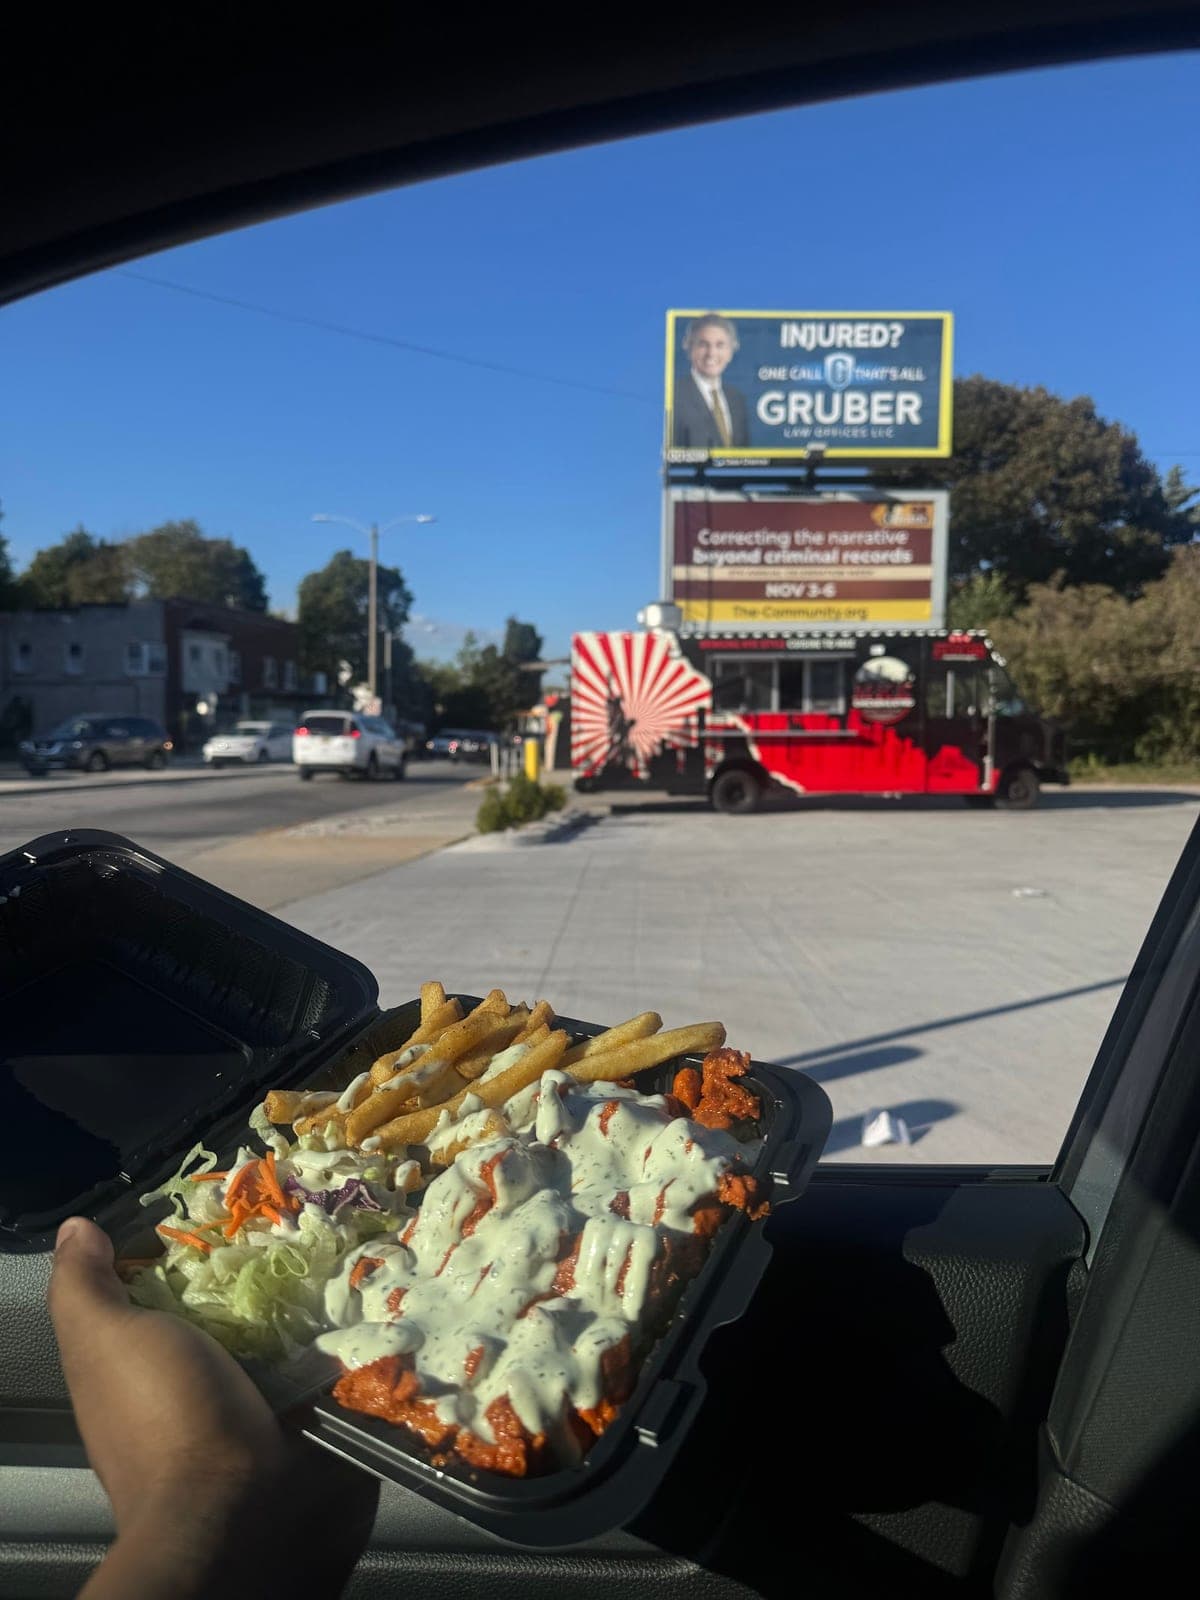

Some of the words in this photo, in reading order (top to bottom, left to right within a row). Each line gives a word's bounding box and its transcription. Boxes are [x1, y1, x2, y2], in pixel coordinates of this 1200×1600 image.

[780, 321, 904, 350] INJURED?
[758, 366, 788, 380] ONE
[789, 366, 822, 380] CALL
[855, 366, 896, 380] THAT'S
[898, 366, 926, 381] ALL
[756, 390, 923, 425] GRUBER
[784, 427, 812, 439] LAW
[815, 427, 869, 439] OFFICES
[870, 427, 895, 439] LLC
[697, 528, 791, 550] Correcting
[793, 528, 824, 545] the
[827, 528, 909, 545] narrative
[692, 546, 762, 567] beyond
[763, 546, 839, 564] criminal
[841, 547, 912, 564] records
[765, 582, 805, 598] NOV
[806, 582, 837, 598] 3-6
